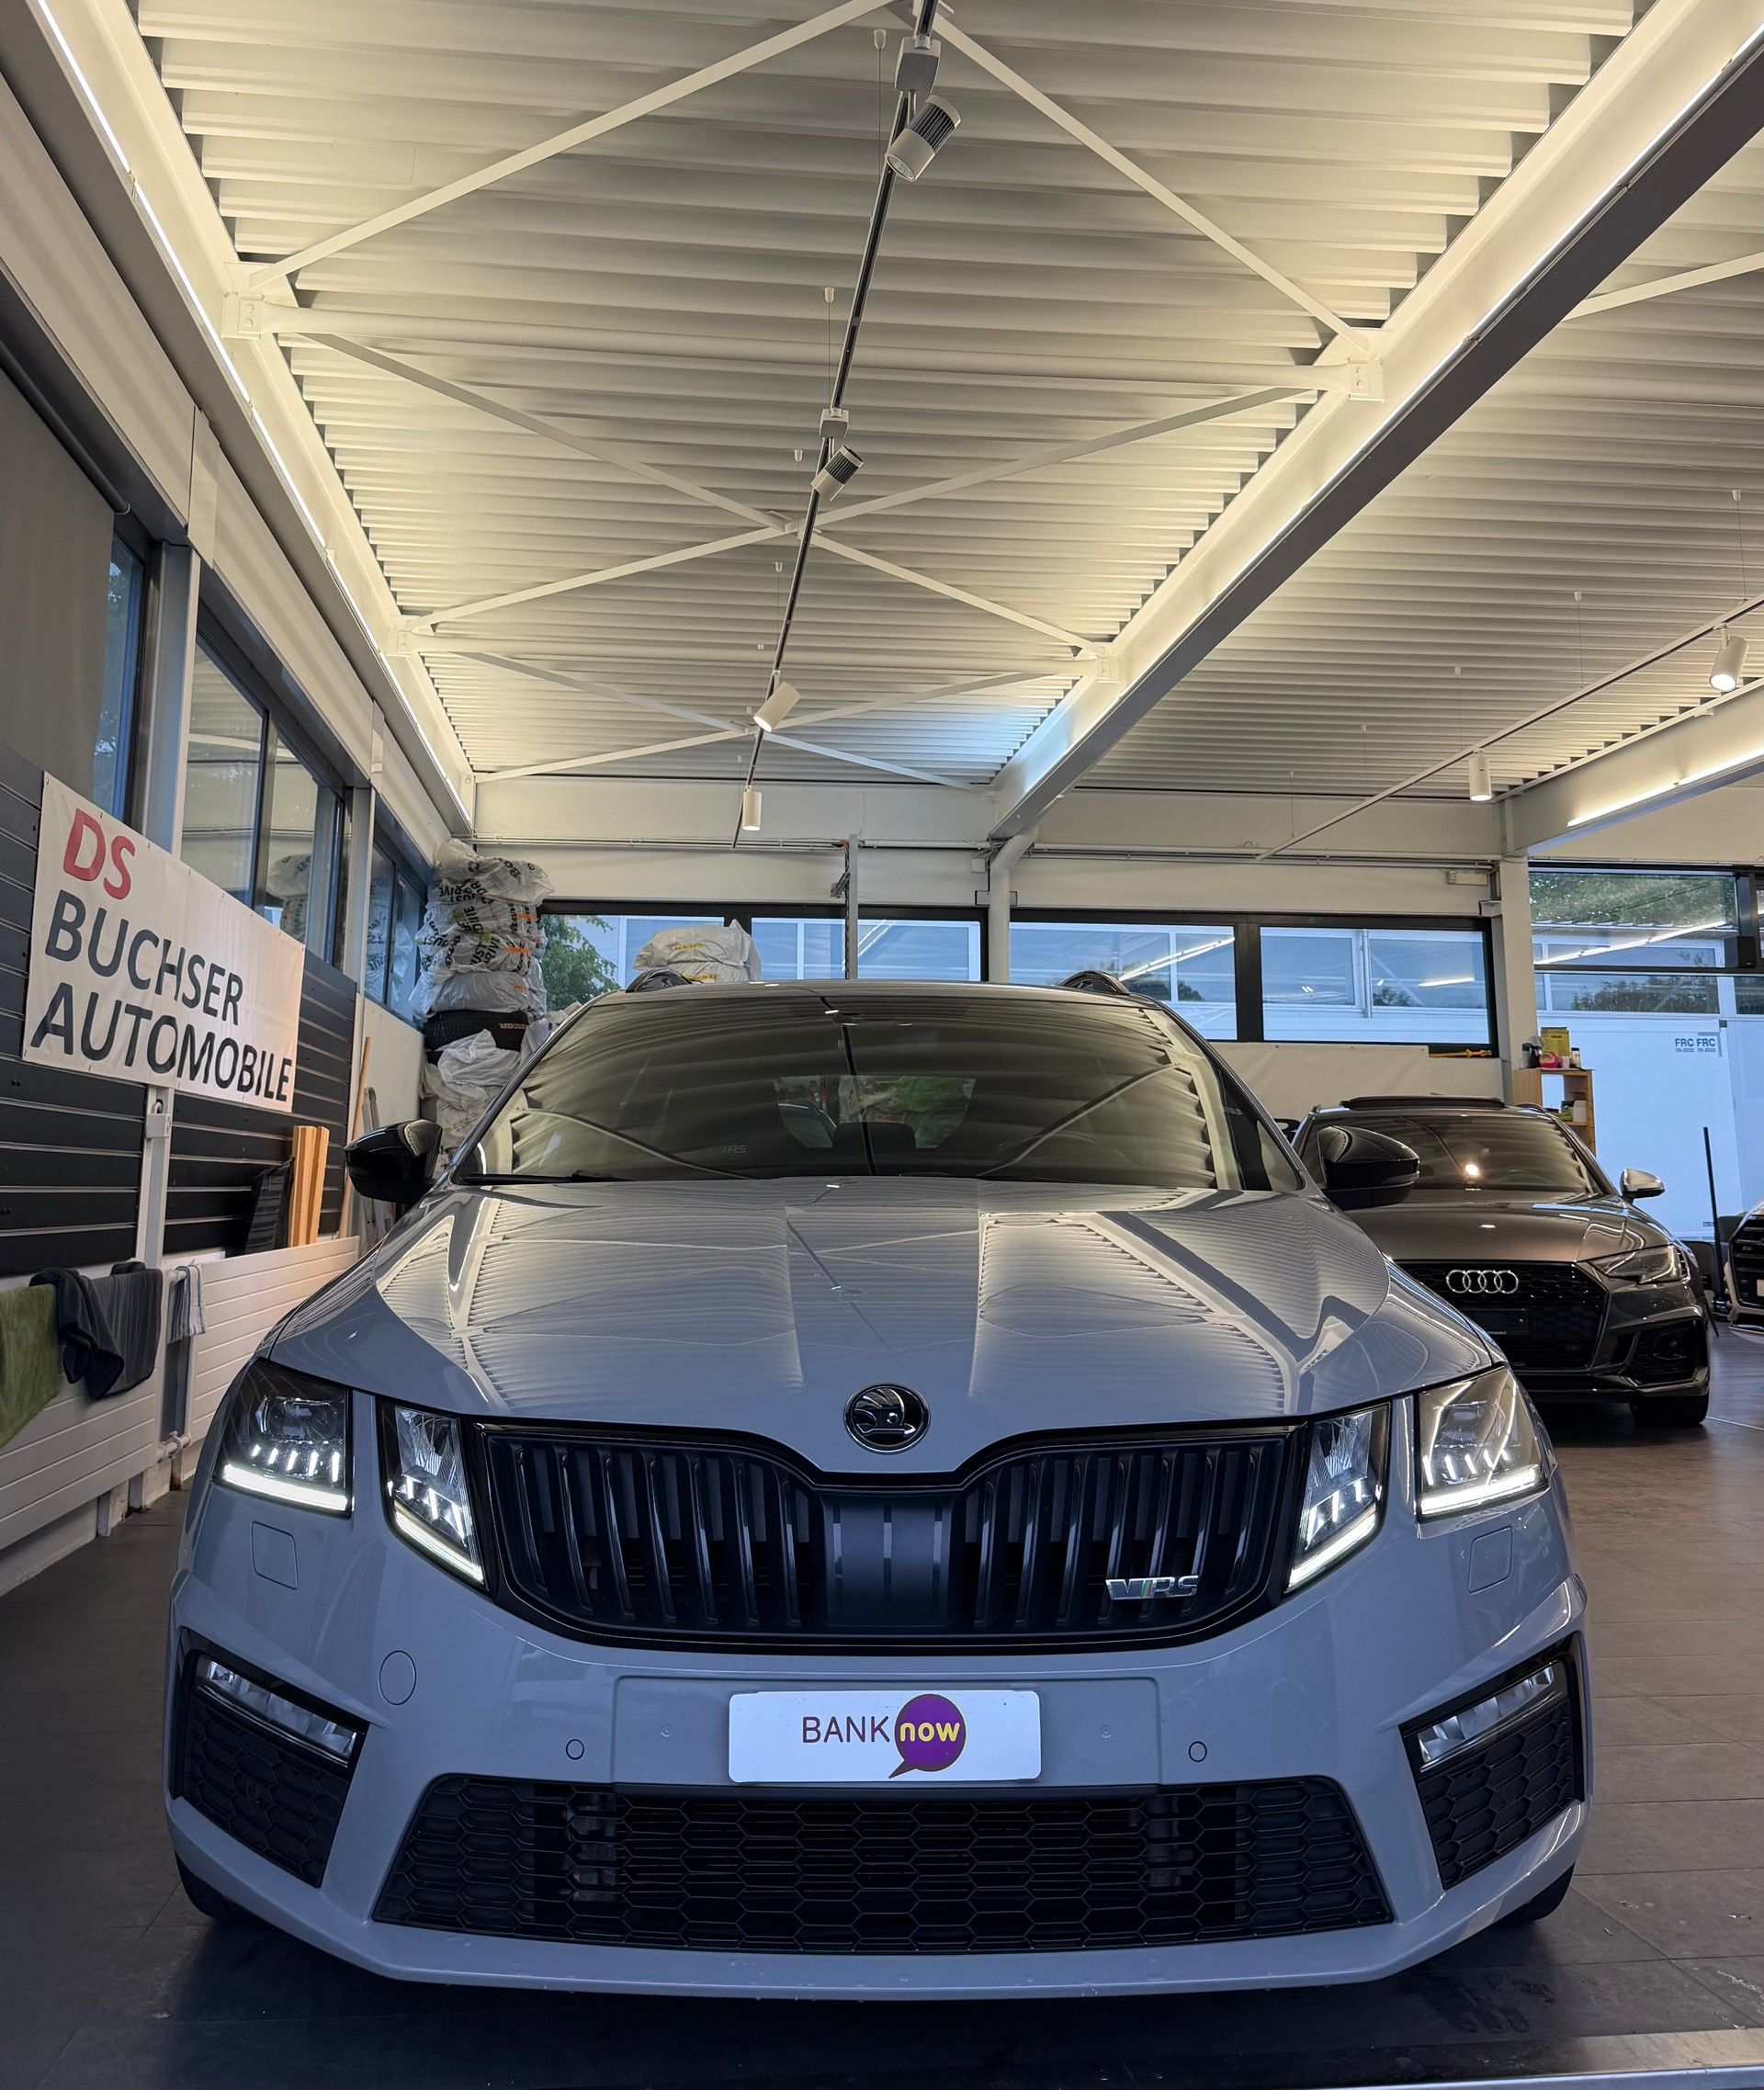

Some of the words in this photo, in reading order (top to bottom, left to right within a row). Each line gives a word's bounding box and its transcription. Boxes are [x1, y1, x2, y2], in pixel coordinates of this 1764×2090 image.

[63, 808, 135, 899] DS
[45, 889, 243, 1025] BUCHSER
[30, 982, 292, 1101] AUTOMOBILE
[1675, 1038, 1694, 1047] FRC
[1697, 1038, 1715, 1047] FRC
[802, 1716, 890, 1743] BANK
[899, 1722, 960, 1742] now
